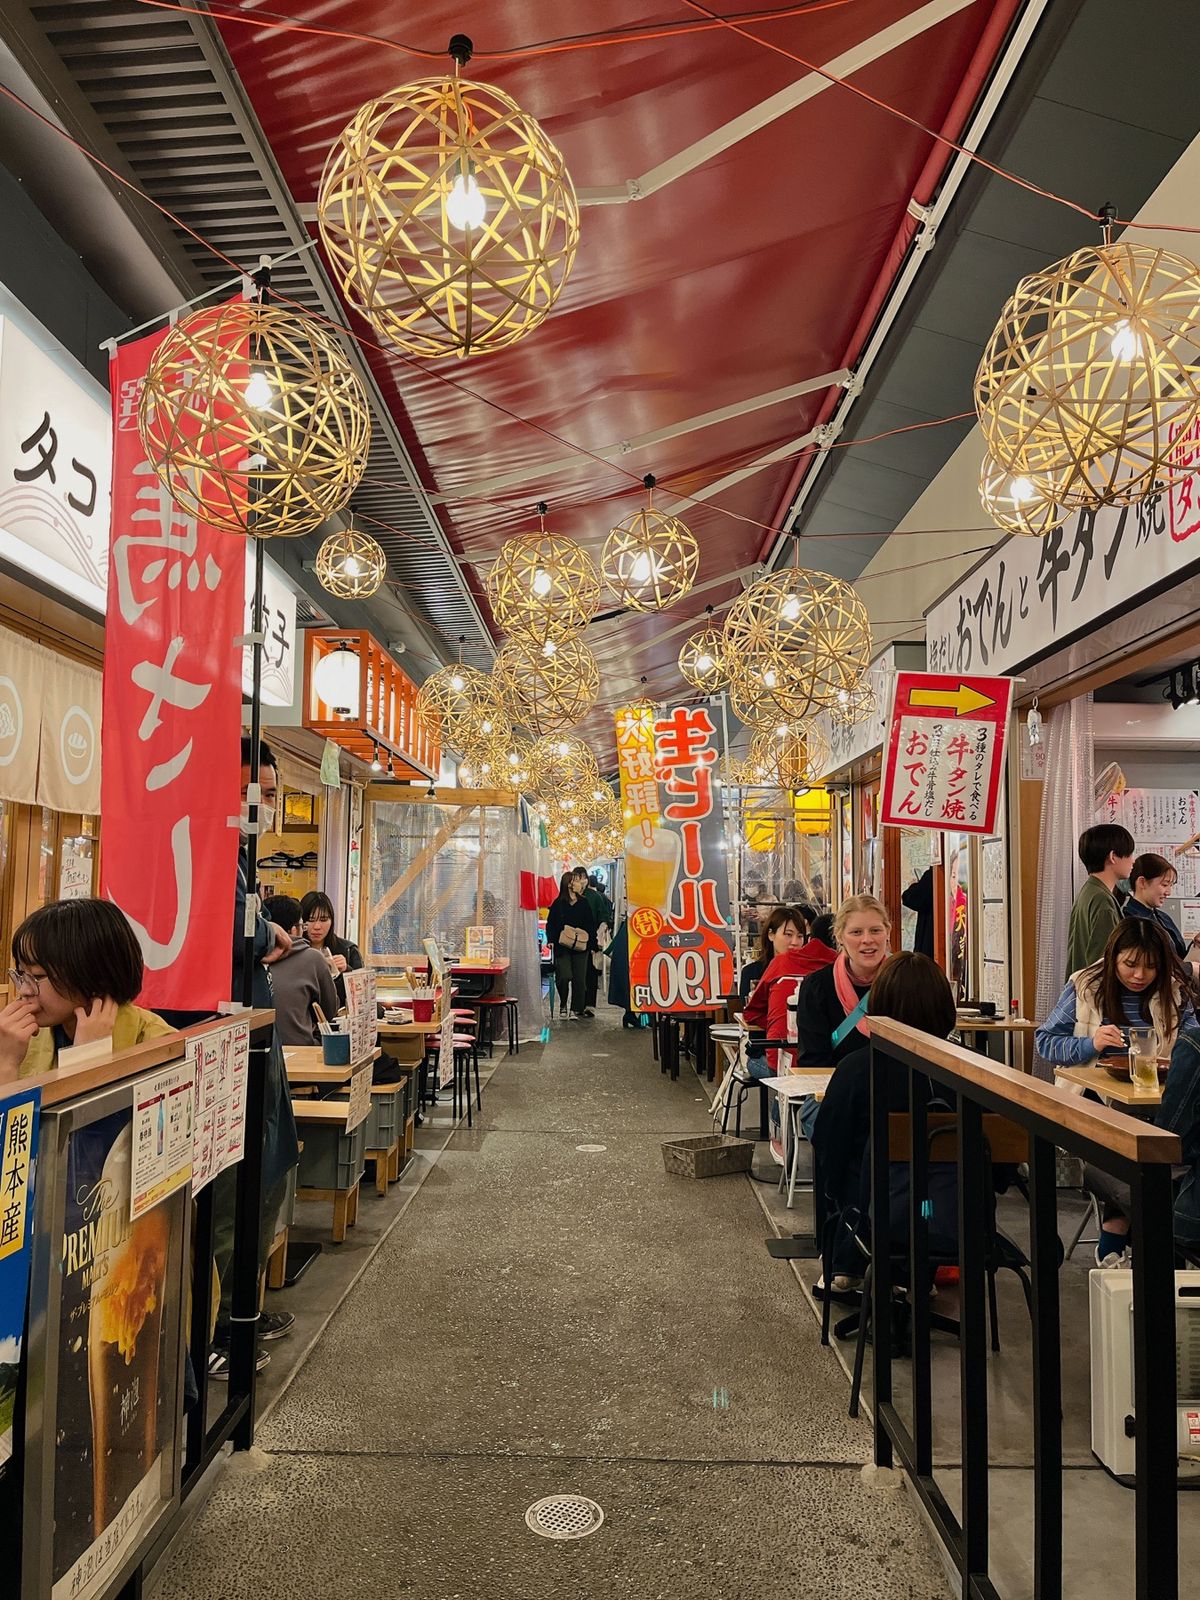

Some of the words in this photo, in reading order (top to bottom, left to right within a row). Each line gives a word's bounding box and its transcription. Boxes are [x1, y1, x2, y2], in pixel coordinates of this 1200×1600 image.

[13, 410, 97, 517] タコ
[898, 730, 929, 815] おでん
[940, 733, 974, 821] 牛タン焼
[969, 727, 988, 821] 3種のタレで食べる
[1178, 797, 1188, 825] おでん
[0, 1113, 28, 1247] 熊本産
[76, 1177, 120, 1221] The
